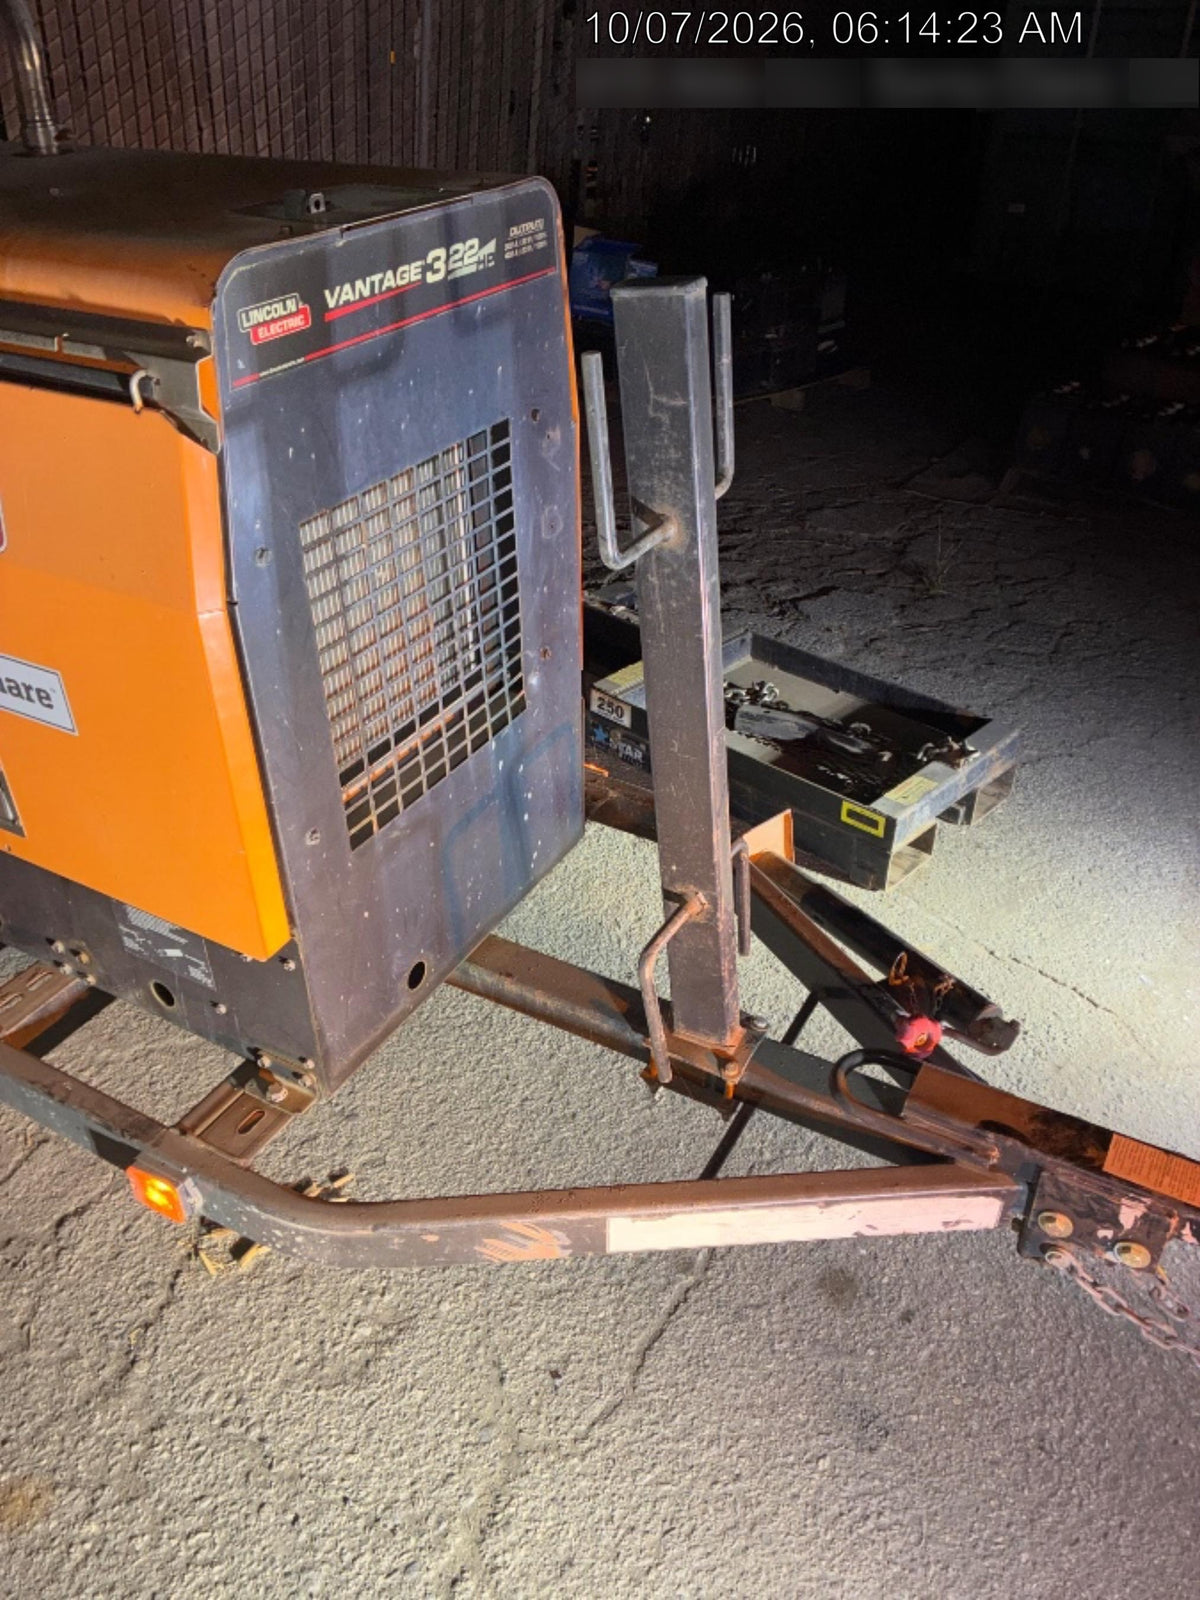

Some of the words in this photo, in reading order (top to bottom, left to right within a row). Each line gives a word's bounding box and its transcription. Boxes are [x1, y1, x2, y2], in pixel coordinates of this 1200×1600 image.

[323, 260, 424, 309] VANTAGE
[241, 298, 297, 328] LINCOLN
[257, 313, 305, 340] ELECTRIC
[597, 696, 624, 719] 250
